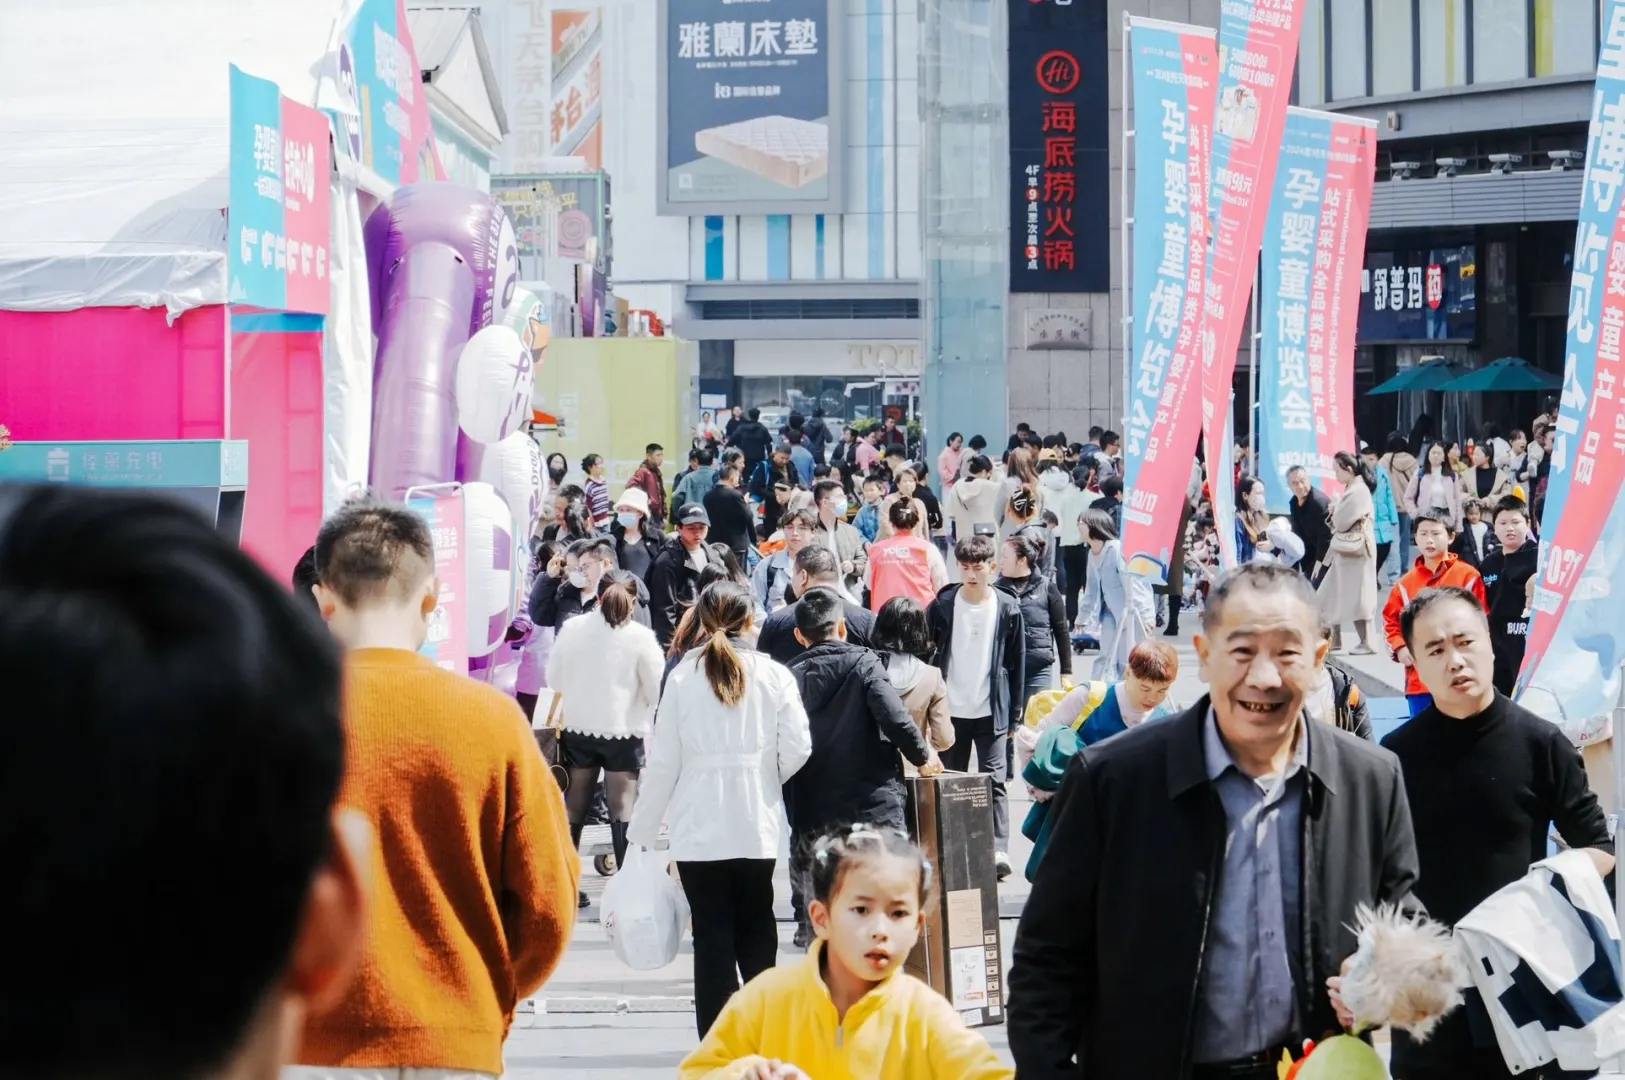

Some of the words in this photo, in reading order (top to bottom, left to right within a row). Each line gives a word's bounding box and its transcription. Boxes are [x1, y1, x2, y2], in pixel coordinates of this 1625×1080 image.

[678, 18, 818, 58] 雅蘭床墊
[1042, 102, 1077, 271] 海底捞火锅
[1128, 98, 1187, 457] 孕婴童博览会
[1276, 168, 1321, 432] 孕婴童博览会
[1309, 173, 1344, 436] 一站式采购全品类孕婴童产品
